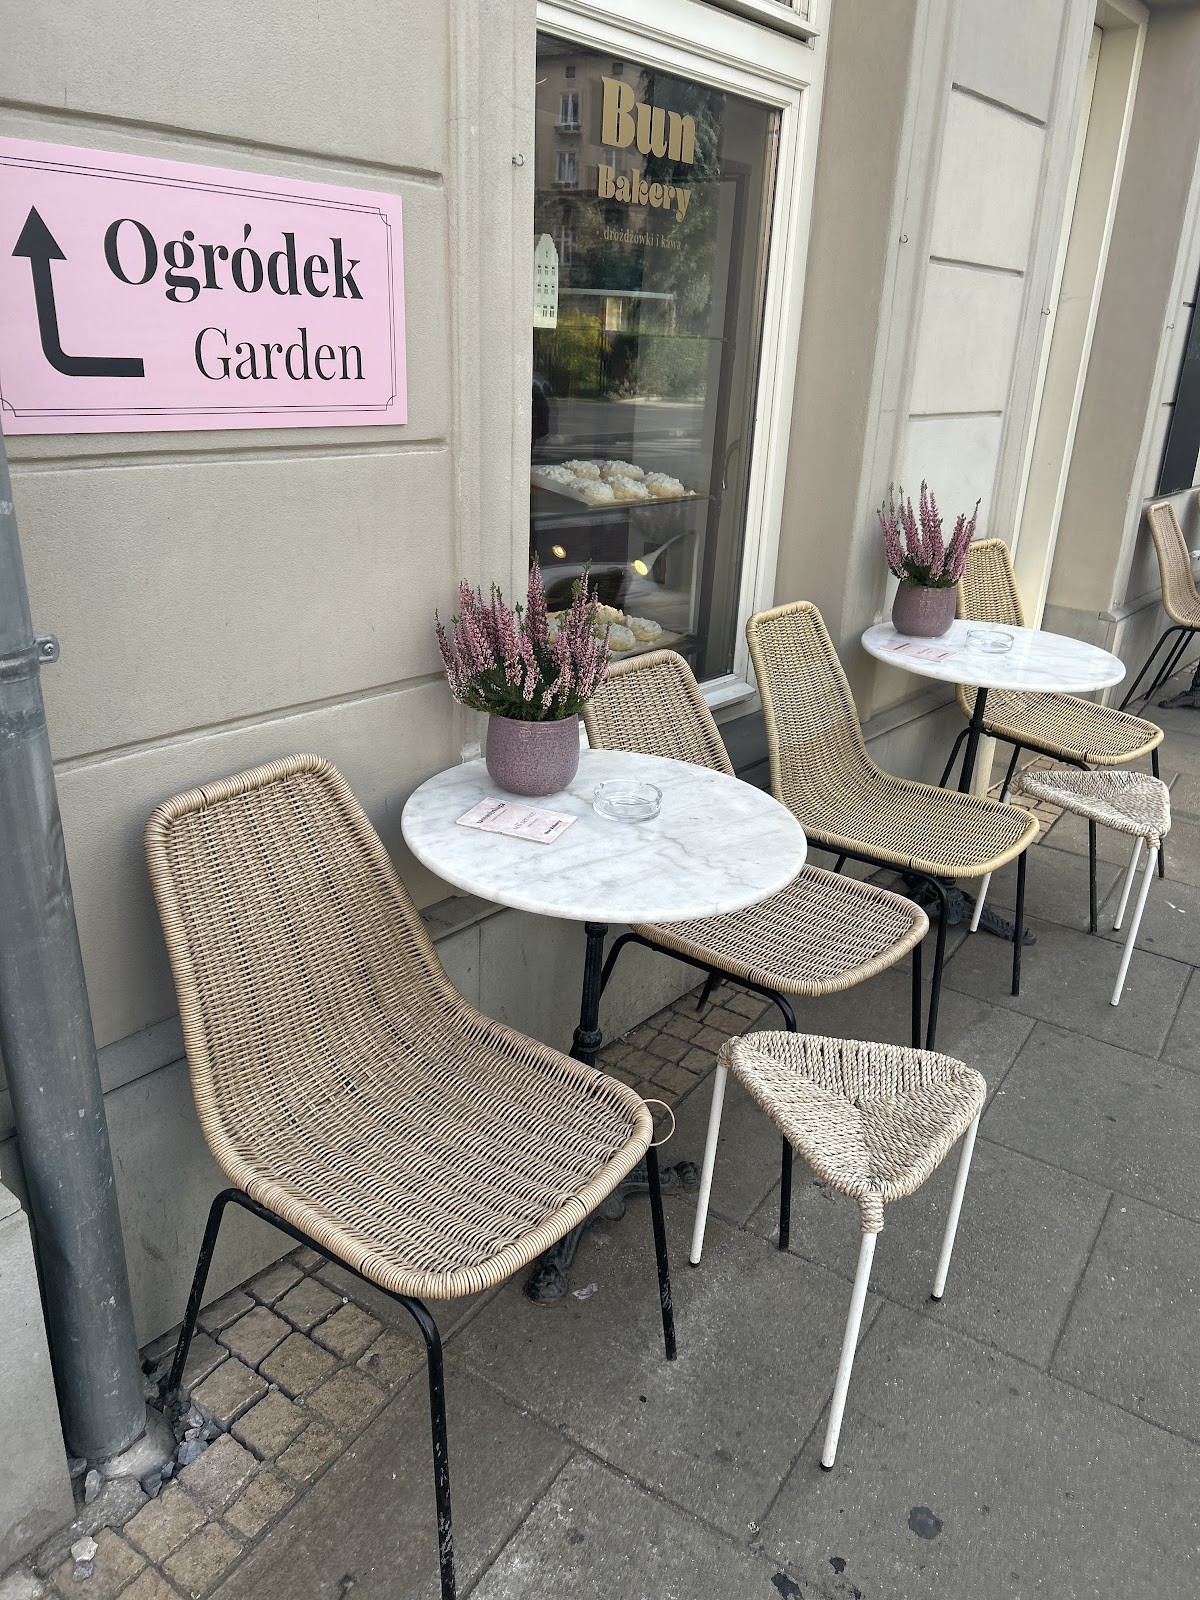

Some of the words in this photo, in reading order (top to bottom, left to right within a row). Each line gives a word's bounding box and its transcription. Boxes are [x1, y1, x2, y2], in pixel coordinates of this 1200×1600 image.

[601, 76, 696, 165] Bun
[598, 163, 692, 223] Bakery
[104, 218, 364, 303] Ogródek
[603, 226, 654, 247] drożdżówki
[655, 233, 660, 247] i
[661, 234, 681, 250] kawa
[194, 327, 366, 381] Garden
